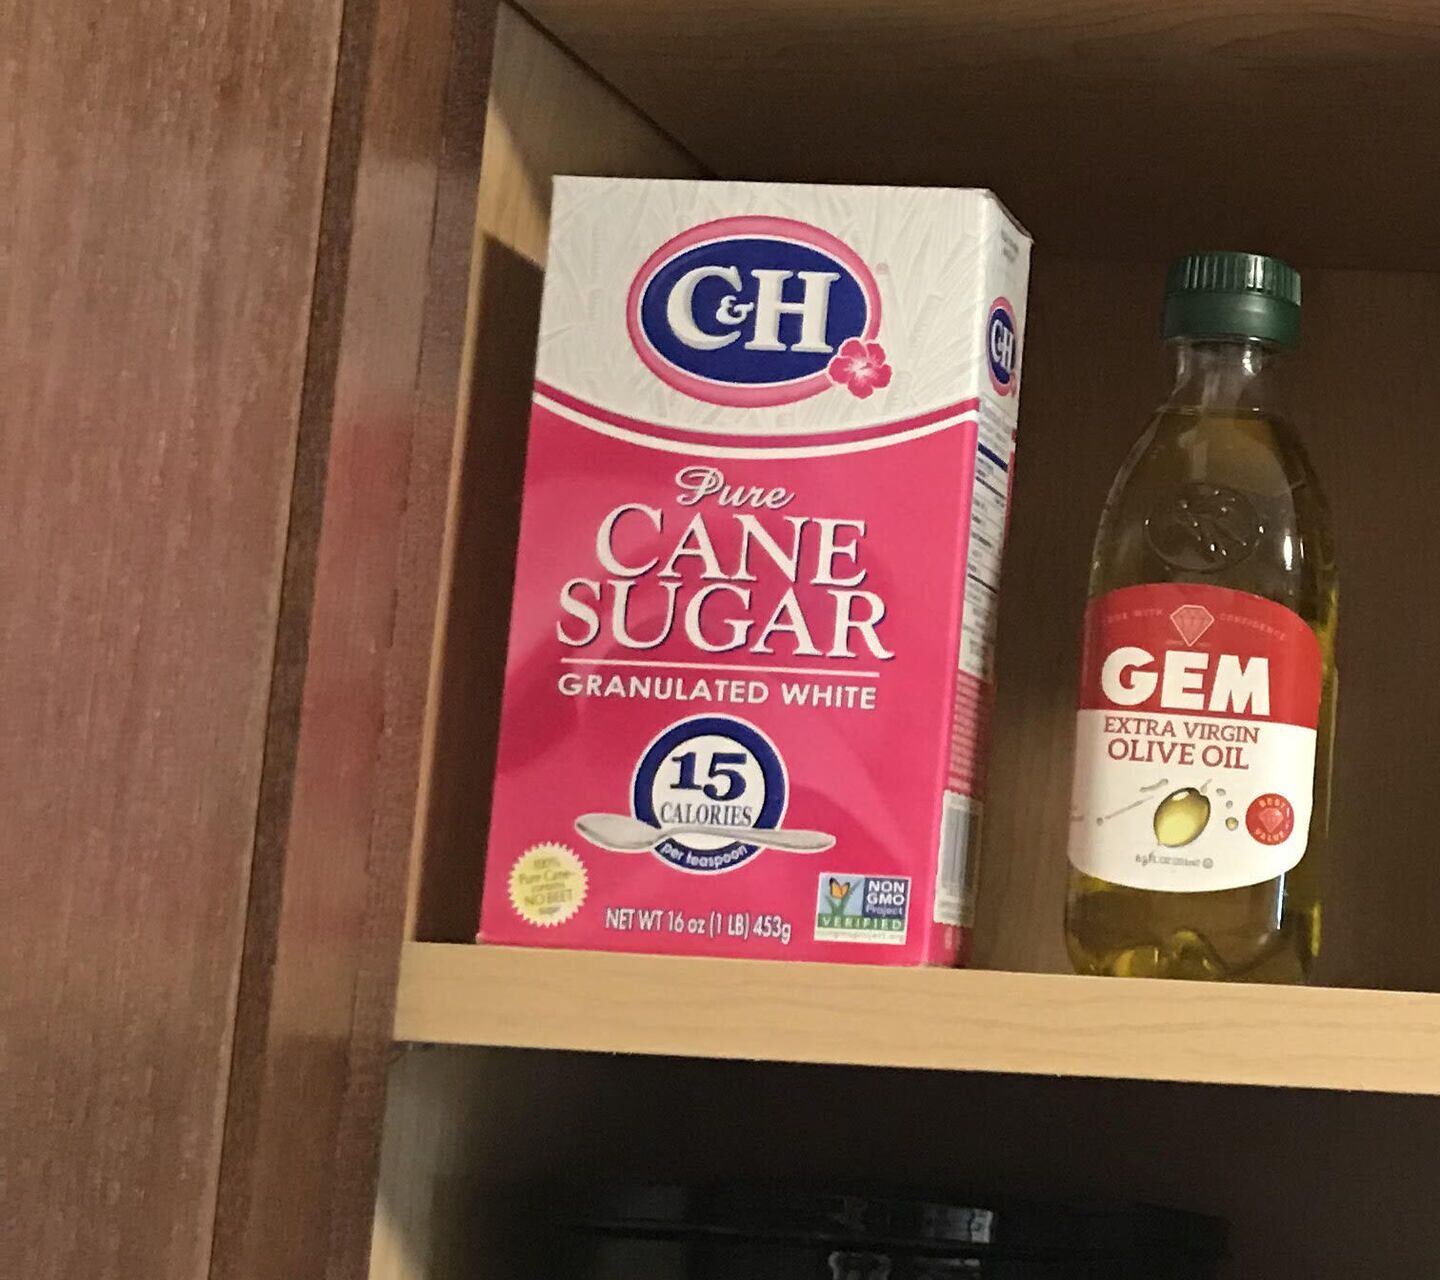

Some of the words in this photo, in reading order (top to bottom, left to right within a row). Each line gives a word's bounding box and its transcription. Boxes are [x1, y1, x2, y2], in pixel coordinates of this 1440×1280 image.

[665, 265, 840, 354] C&H
[675, 466, 795, 509] Pure
[595, 502, 868, 588] CANE
[556, 578, 897, 661] SUGAR
[557, 673, 769, 705] GRANULATED
[781, 682, 878, 710] WHITE
[1101, 646, 1271, 716] GEM
[1104, 715, 1176, 738] EXTRA
[1184, 721, 1261, 744] VIRGIN
[1107, 738, 1195, 766] OLIVE
[1201, 745, 1249, 770] OIL
[670, 752, 748, 801] 15
[660, 801, 753, 828] CALORIES
[660, 842, 683, 861] per
[685, 844, 748, 868] teaspoon
[866, 893, 905, 906] GMO
[868, 880, 905, 893] NON
[605, 907, 635, 930] NET
[636, 909, 664, 931] WT
[668, 910, 685, 933] 16
[687, 918, 706, 934] oz
[709, 911, 722, 937] (1
[727, 911, 750, 939] LB)
[753, 914, 792, 944] 453g
[822, 916, 903, 930] VERIFIED
[865, 905, 903, 916] Project
